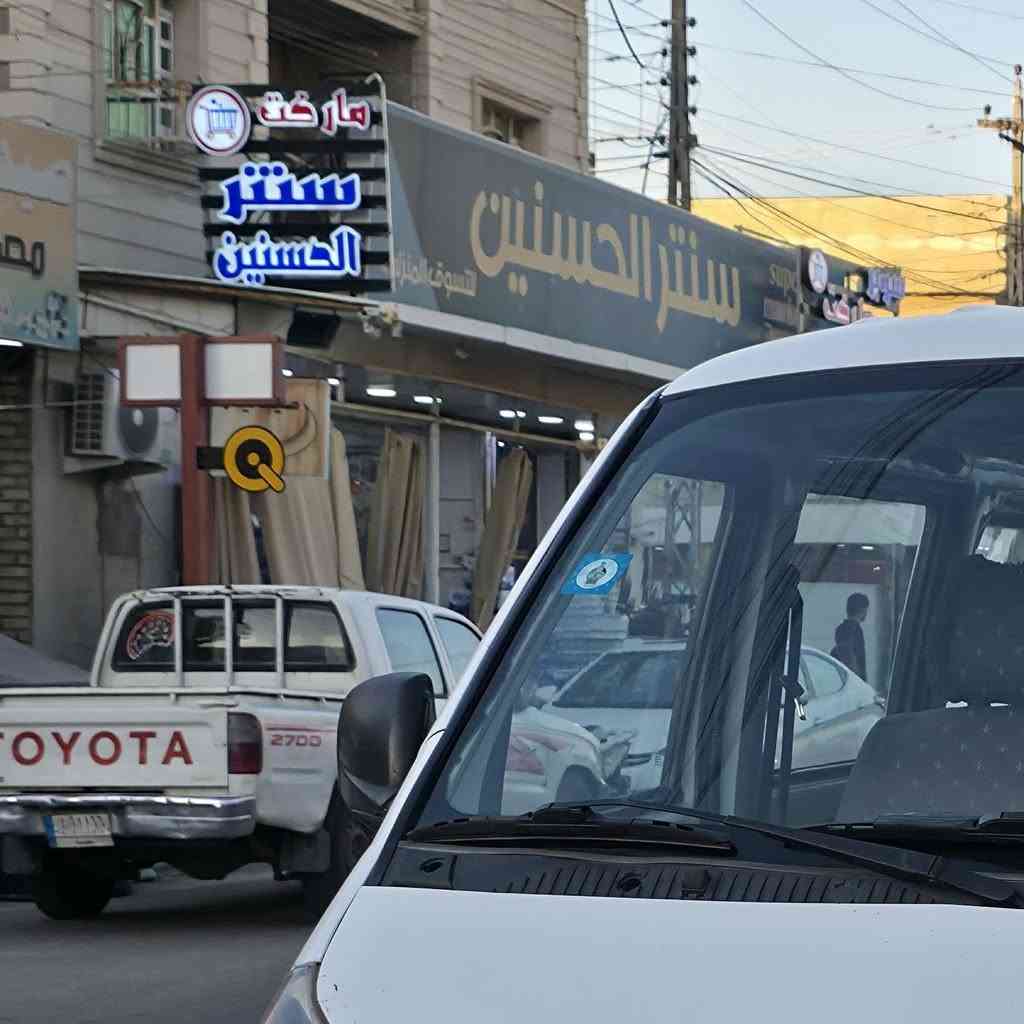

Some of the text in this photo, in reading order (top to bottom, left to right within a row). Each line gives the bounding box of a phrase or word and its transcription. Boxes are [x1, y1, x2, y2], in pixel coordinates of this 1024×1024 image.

[219, 162, 361, 223] سنتر
[213, 225, 361, 285] الحسنين
[470, 181, 741, 333] سنتر الحسنين
[0, 731, 193, 766] OYOTA
[271, 735, 322, 747] 2700
